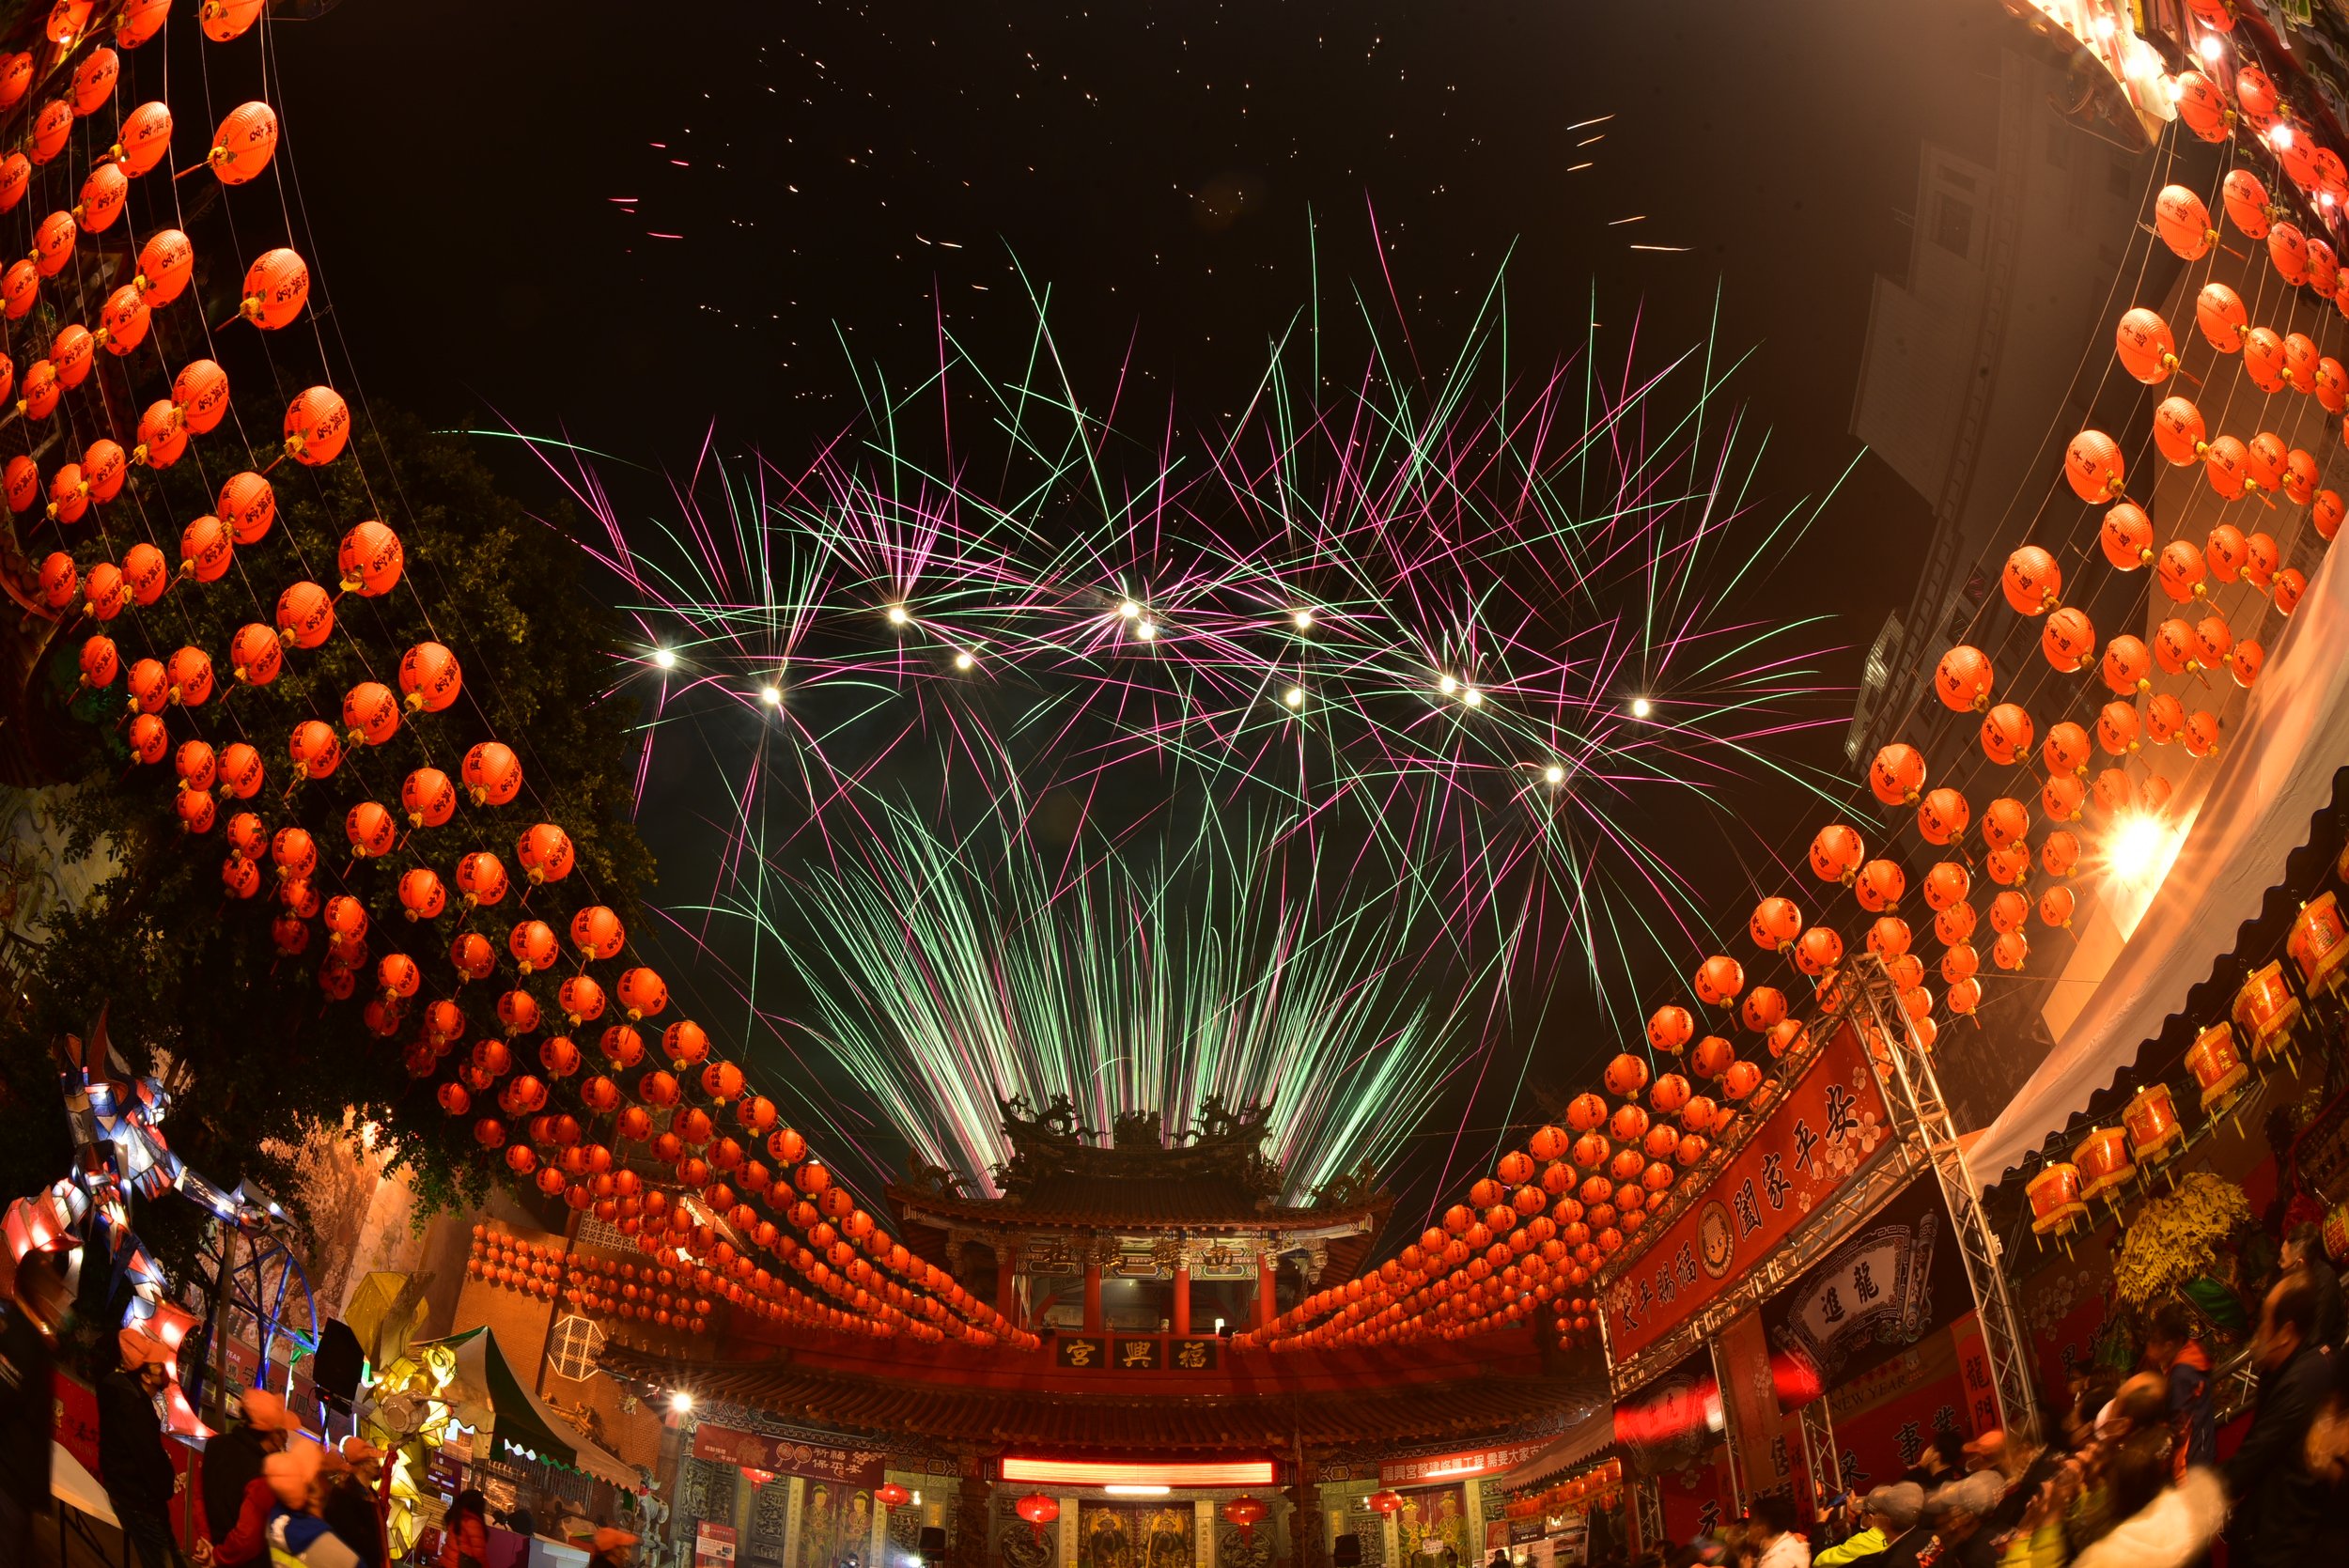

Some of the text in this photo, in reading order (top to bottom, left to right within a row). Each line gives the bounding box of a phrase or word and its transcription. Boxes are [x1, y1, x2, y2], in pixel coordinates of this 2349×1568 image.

[1733, 1083, 1859, 1241] 闔家平安
[1622, 1241, 1698, 1336] 太平賜福
[226, 1350, 241, 1362] YEAR
[1831, 1390, 1864, 1414] NEW
[1868, 1374, 1907, 1400] YEAR
[1967, 1355, 1997, 1433] 龍門
[812, 1459, 863, 1479] 保平安
